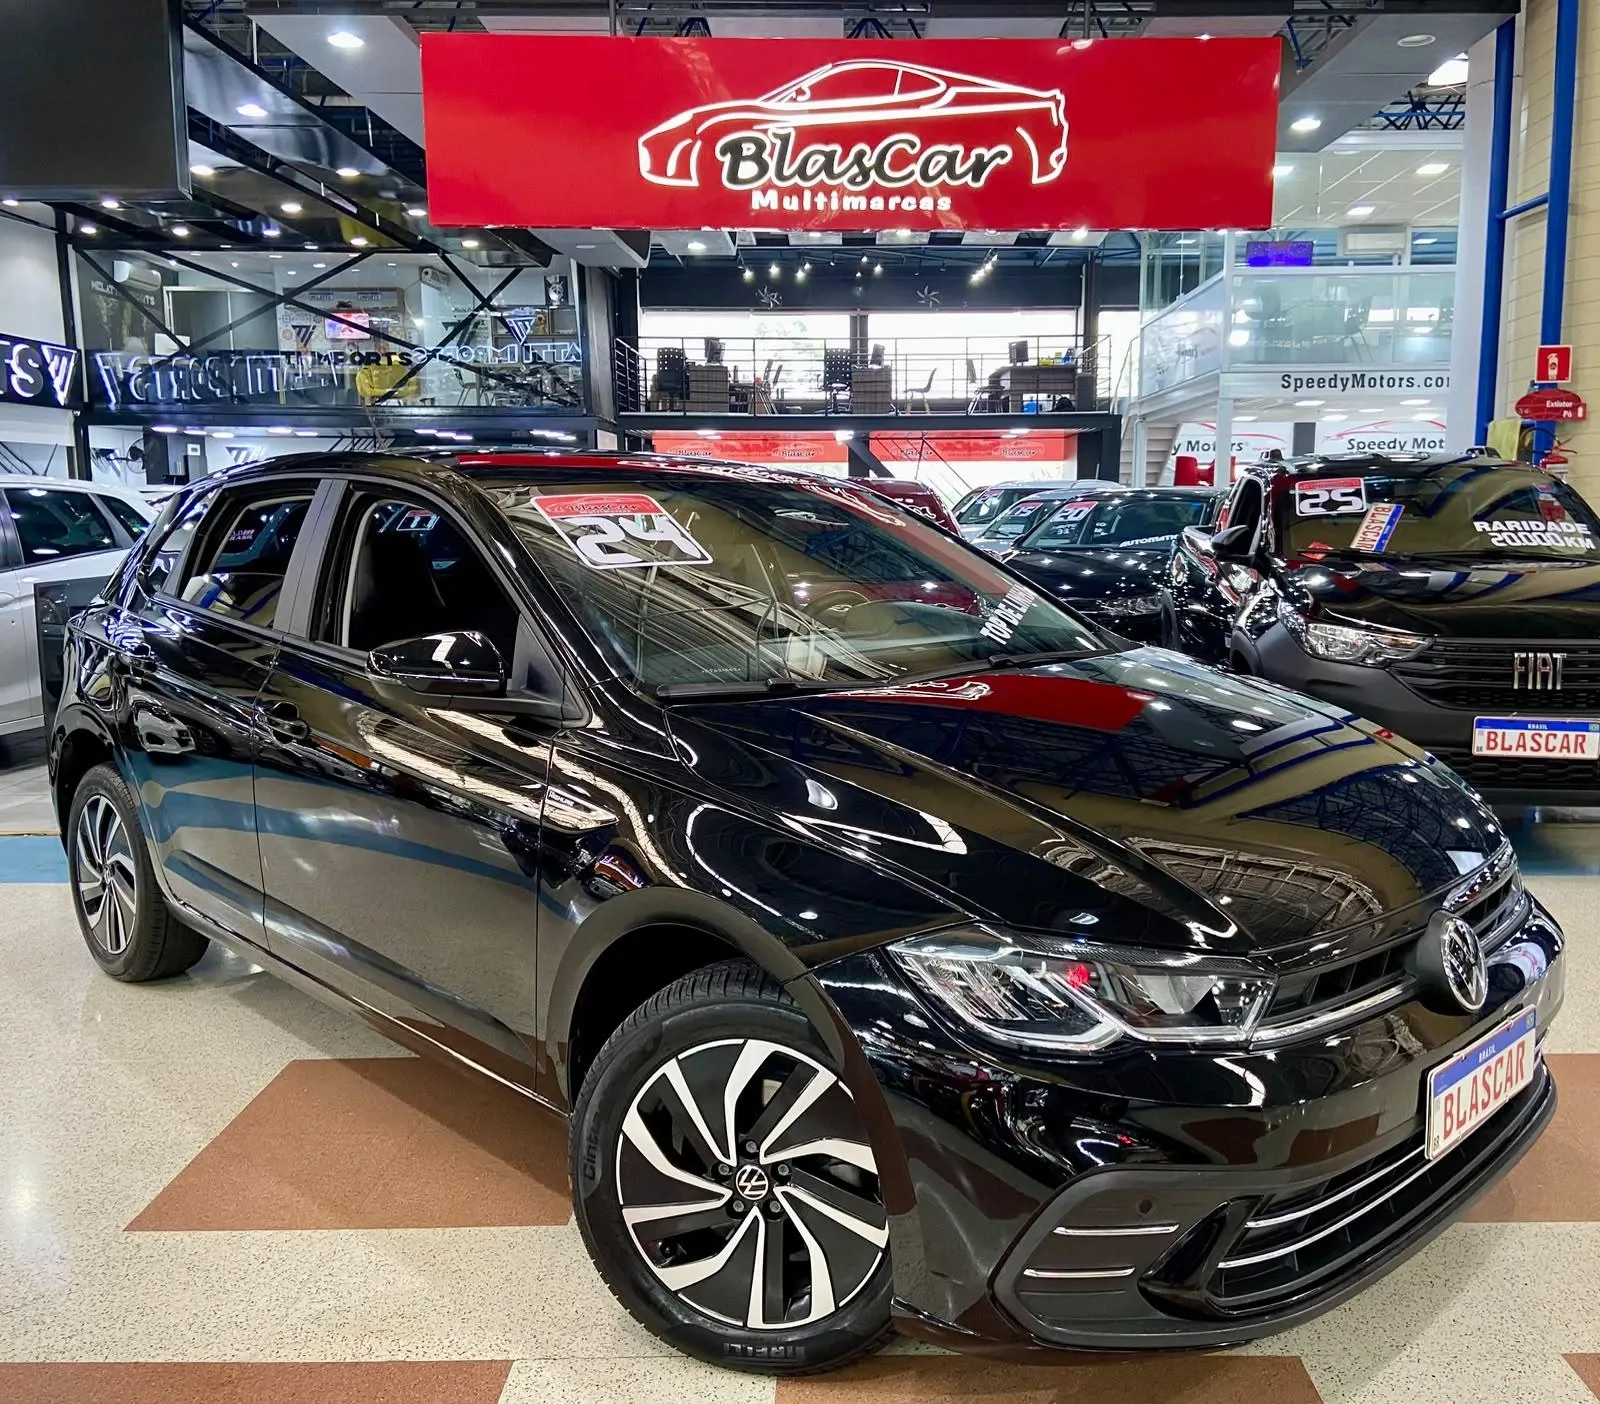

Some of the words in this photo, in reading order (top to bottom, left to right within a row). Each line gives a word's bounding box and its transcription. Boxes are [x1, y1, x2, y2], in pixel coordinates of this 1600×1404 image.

[717, 127, 1012, 190] BlasCar
[751, 189, 952, 212] Multimarcas
[1186, 440, 1244, 452] Motrs
[1347, 438, 1408, 451] Speedy
[1299, 488, 1363, 513] 25
[563, 514, 702, 563] 24
[1357, 506, 1392, 551] BLASCAR
[1473, 520, 1592, 535] RARIDADE
[980, 615, 1014, 645] TOP
[1513, 652, 1567, 690] FIAT
[1486, 731, 1587, 754] BLASCAR
[1443, 1040, 1526, 1140] BLASCAR
